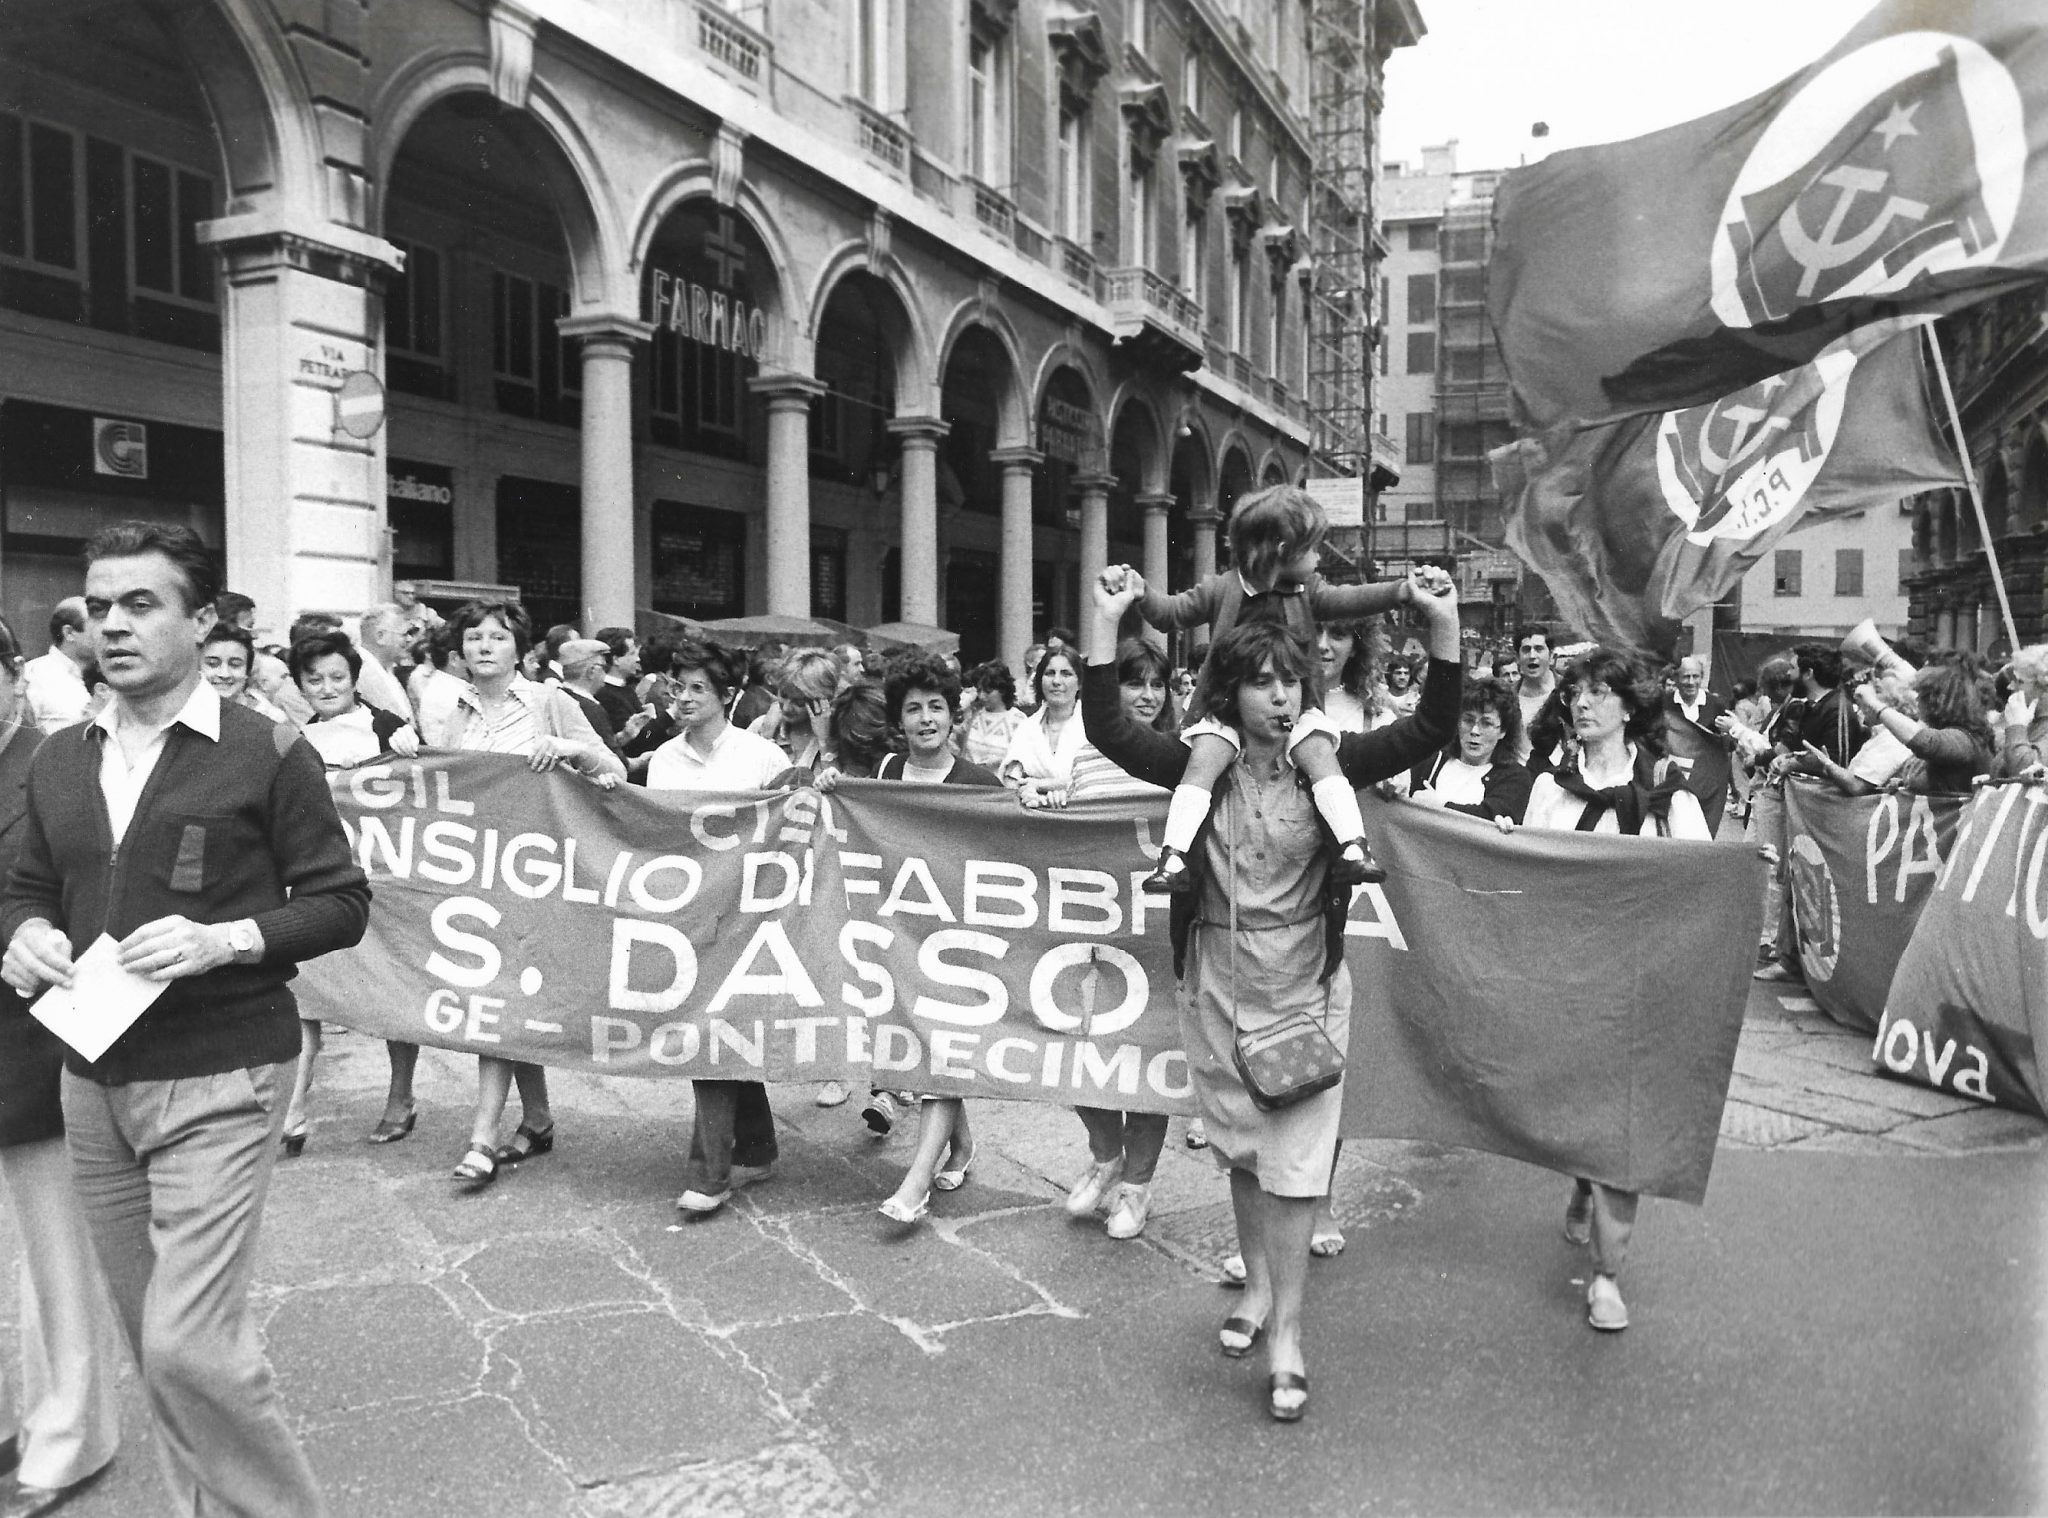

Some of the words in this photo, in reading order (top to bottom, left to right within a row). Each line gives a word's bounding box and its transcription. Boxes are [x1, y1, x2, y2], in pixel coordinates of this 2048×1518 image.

[320, 344, 344, 361] VIA
[326, 764, 476, 816] GIL
[341, 816, 702, 912] NSIGLIO
[740, 848, 814, 913] DI
[425, 896, 543, 996] S.
[608, 917, 1150, 1036] DASSO
[424, 988, 507, 1043] GE
[591, 1015, 1194, 1098] PONTEDECIMO
